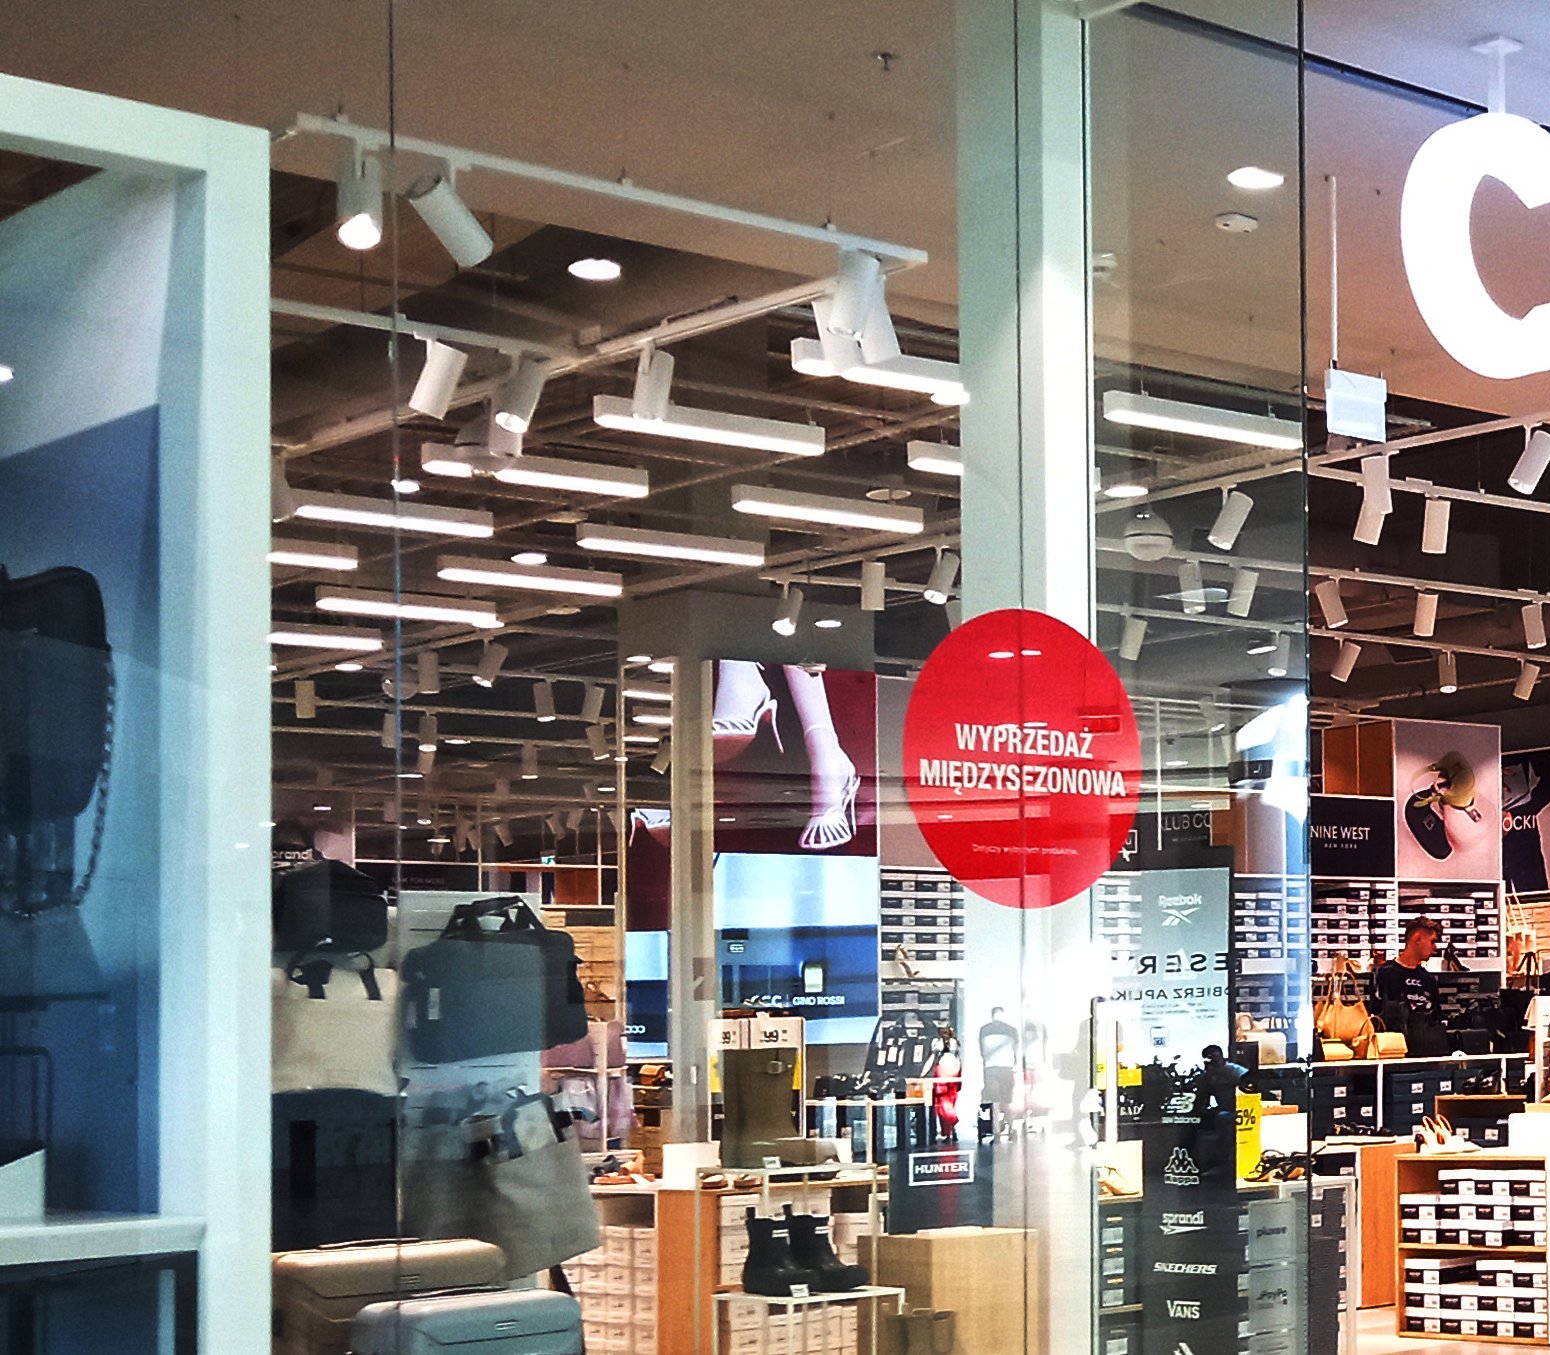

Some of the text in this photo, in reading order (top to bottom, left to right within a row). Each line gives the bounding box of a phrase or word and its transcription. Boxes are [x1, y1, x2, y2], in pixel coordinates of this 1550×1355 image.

[955, 723, 1094, 759] WYPRZEDAŻ
[920, 758, 1127, 797] MIĘDZYSEZONOWA
[1310, 825, 1371, 840] NINE WEST
[1158, 893, 1202, 906] Reebok
[817, 995, 846, 1005] ROSSI
[914, 1162, 969, 1175] HUNTER
[1161, 1210, 1205, 1225] sprandi
[1153, 1261, 1218, 1275] SKECHERS
[1166, 1299, 1201, 1319] VANS
